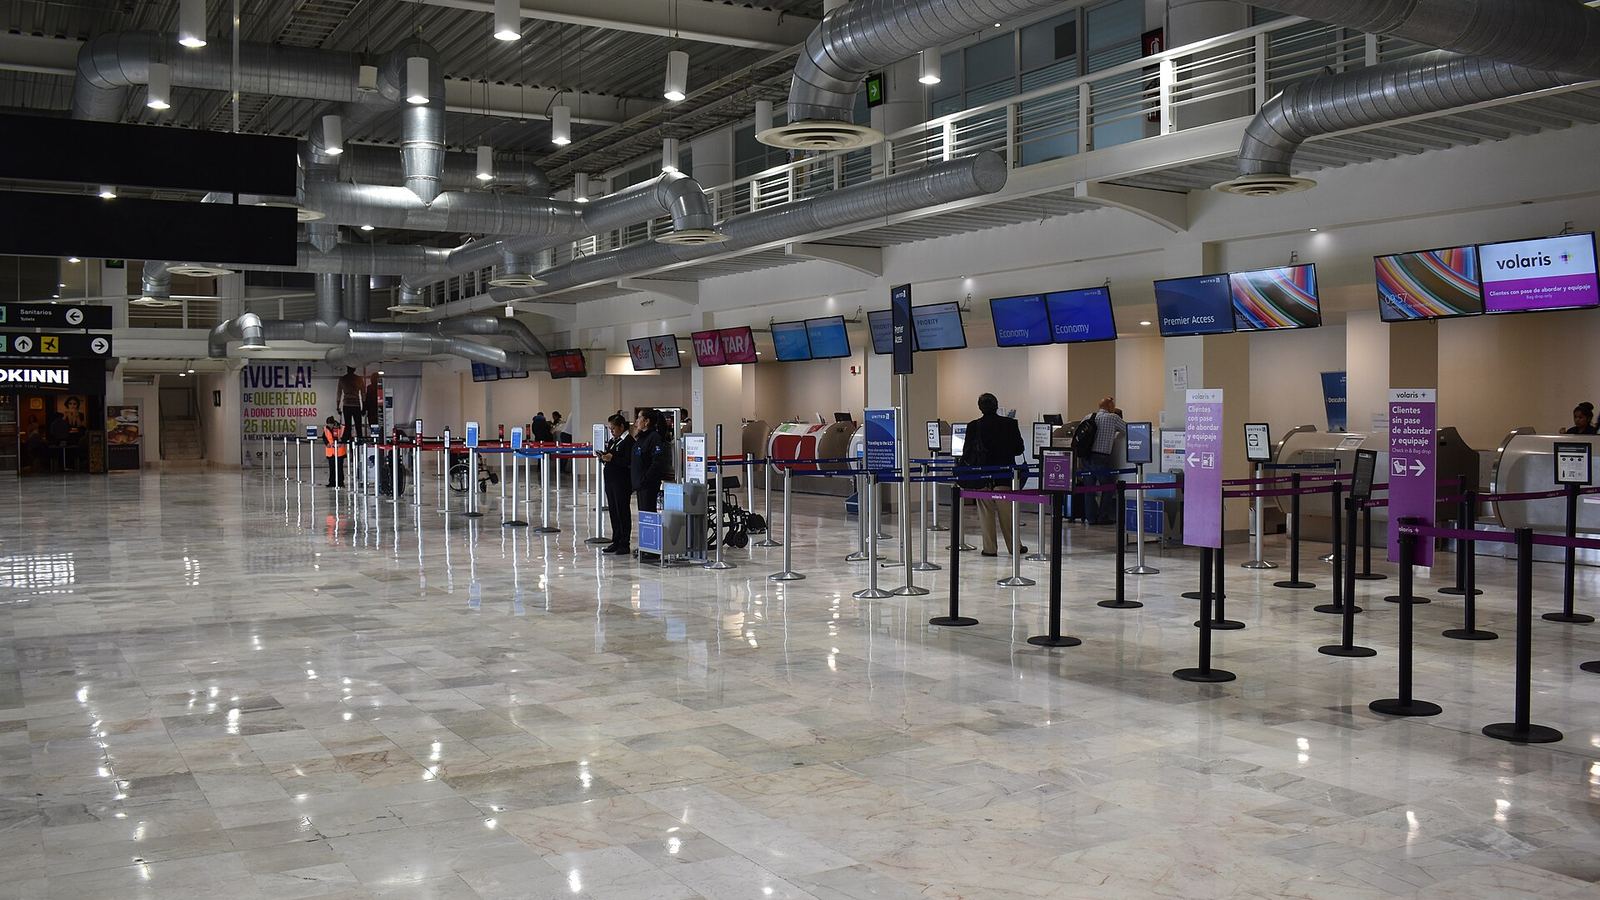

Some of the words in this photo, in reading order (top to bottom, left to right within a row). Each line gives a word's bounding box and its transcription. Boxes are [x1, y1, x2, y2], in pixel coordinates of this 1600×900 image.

[1496, 252, 1551, 270] volaris
[1385, 291, 1408, 304] 09:57
[1164, 317, 1190, 326] Premier
[1192, 314, 1214, 324] Access
[1000, 328, 1029, 338] Economy
[1056, 324, 1090, 334] Economy
[695, 339, 714, 356] TAR
[722, 336, 743, 354] TAR
[244, 366, 312, 388] ¡VUELA!
[244, 393, 252, 402] DE
[254, 390, 316, 406] QUERÉTARO
[244, 408, 249, 418] A
[250, 408, 274, 418] DONDE
[276, 407, 285, 418] TÚ
[287, 408, 316, 417] QUIERAS
[244, 419, 258, 433] 25
[262, 419, 296, 432] RUTAS
[1402, 426, 1432, 434] abordar
[1192, 434, 1216, 442] equipaje
[1392, 438, 1396, 446] y
[1398, 437, 1429, 446] equipaje
